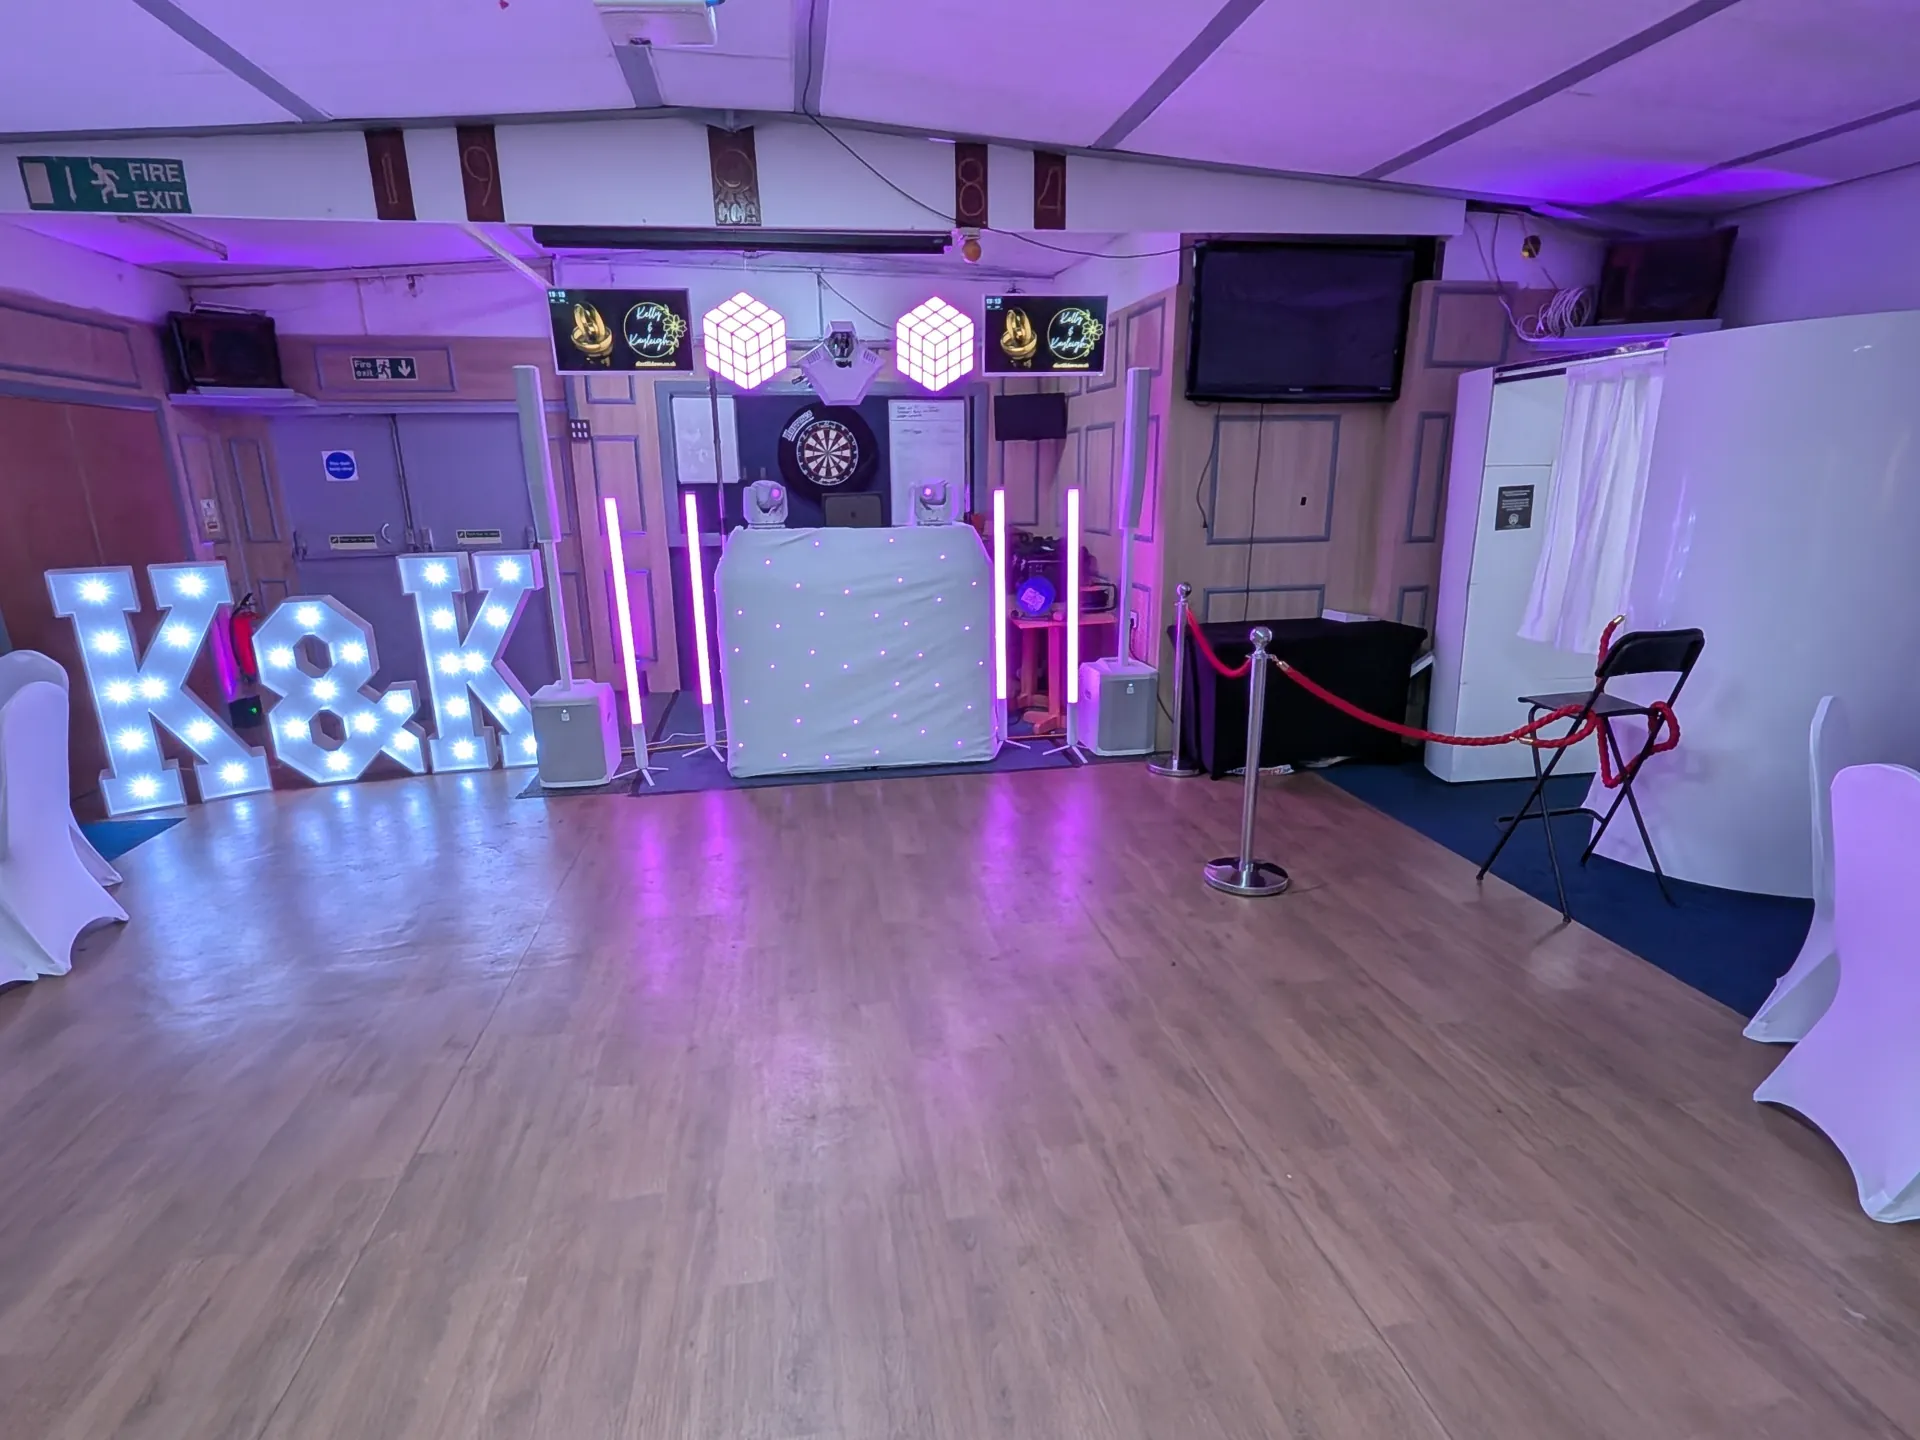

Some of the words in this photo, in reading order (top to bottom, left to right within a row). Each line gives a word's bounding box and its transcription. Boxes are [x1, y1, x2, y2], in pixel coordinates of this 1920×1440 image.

[127, 162, 181, 183] FIRE
[132, 190, 183, 210] EXIT
[636, 305, 662, 322] Kelly
[1060, 311, 1084, 326] Kelly
[629, 333, 668, 351] Kayleigh
[354, 360, 372, 368] Fire
[356, 369, 374, 377] exit
